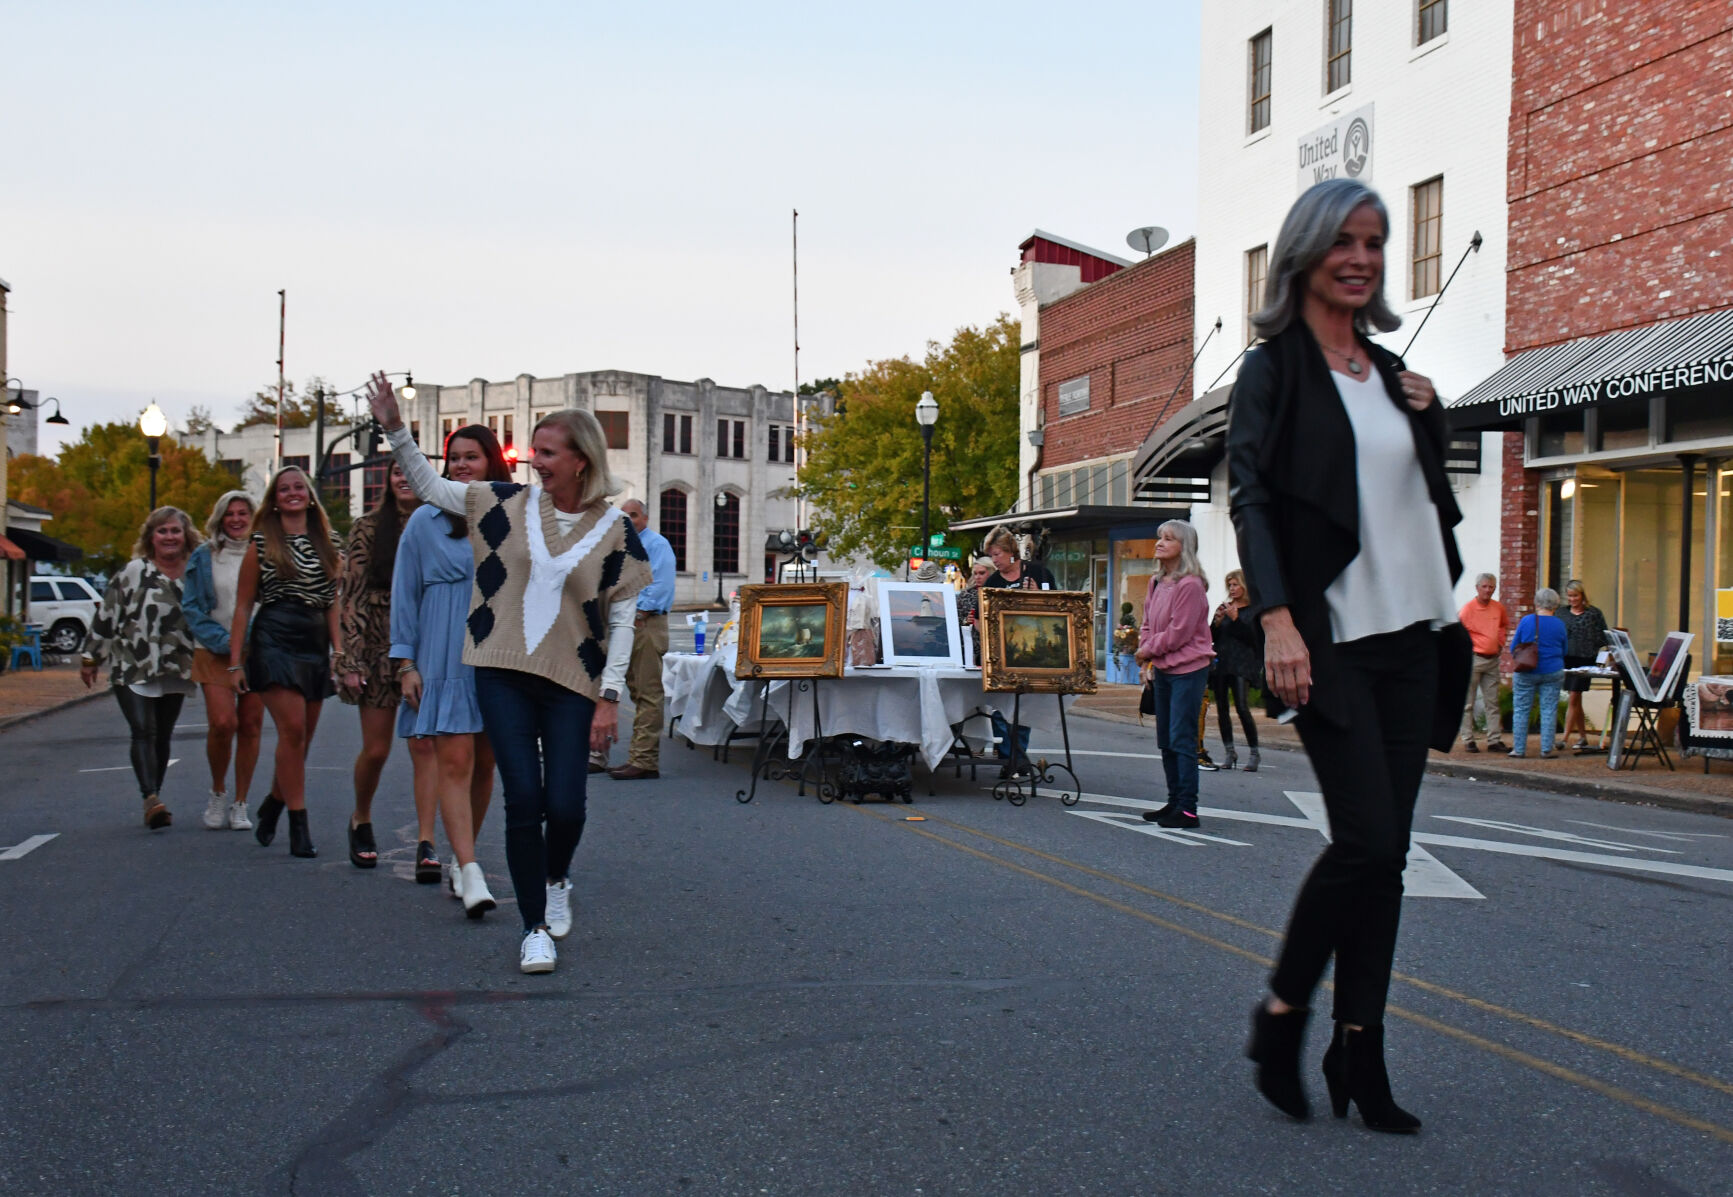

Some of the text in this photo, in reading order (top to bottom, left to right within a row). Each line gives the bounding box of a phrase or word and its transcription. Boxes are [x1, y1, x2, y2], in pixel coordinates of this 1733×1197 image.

[1299, 128, 1337, 169] United
[1499, 391, 1559, 416] UNITED
[1563, 383, 1602, 407] WAY
[914, 547, 950, 557] Cahoun
